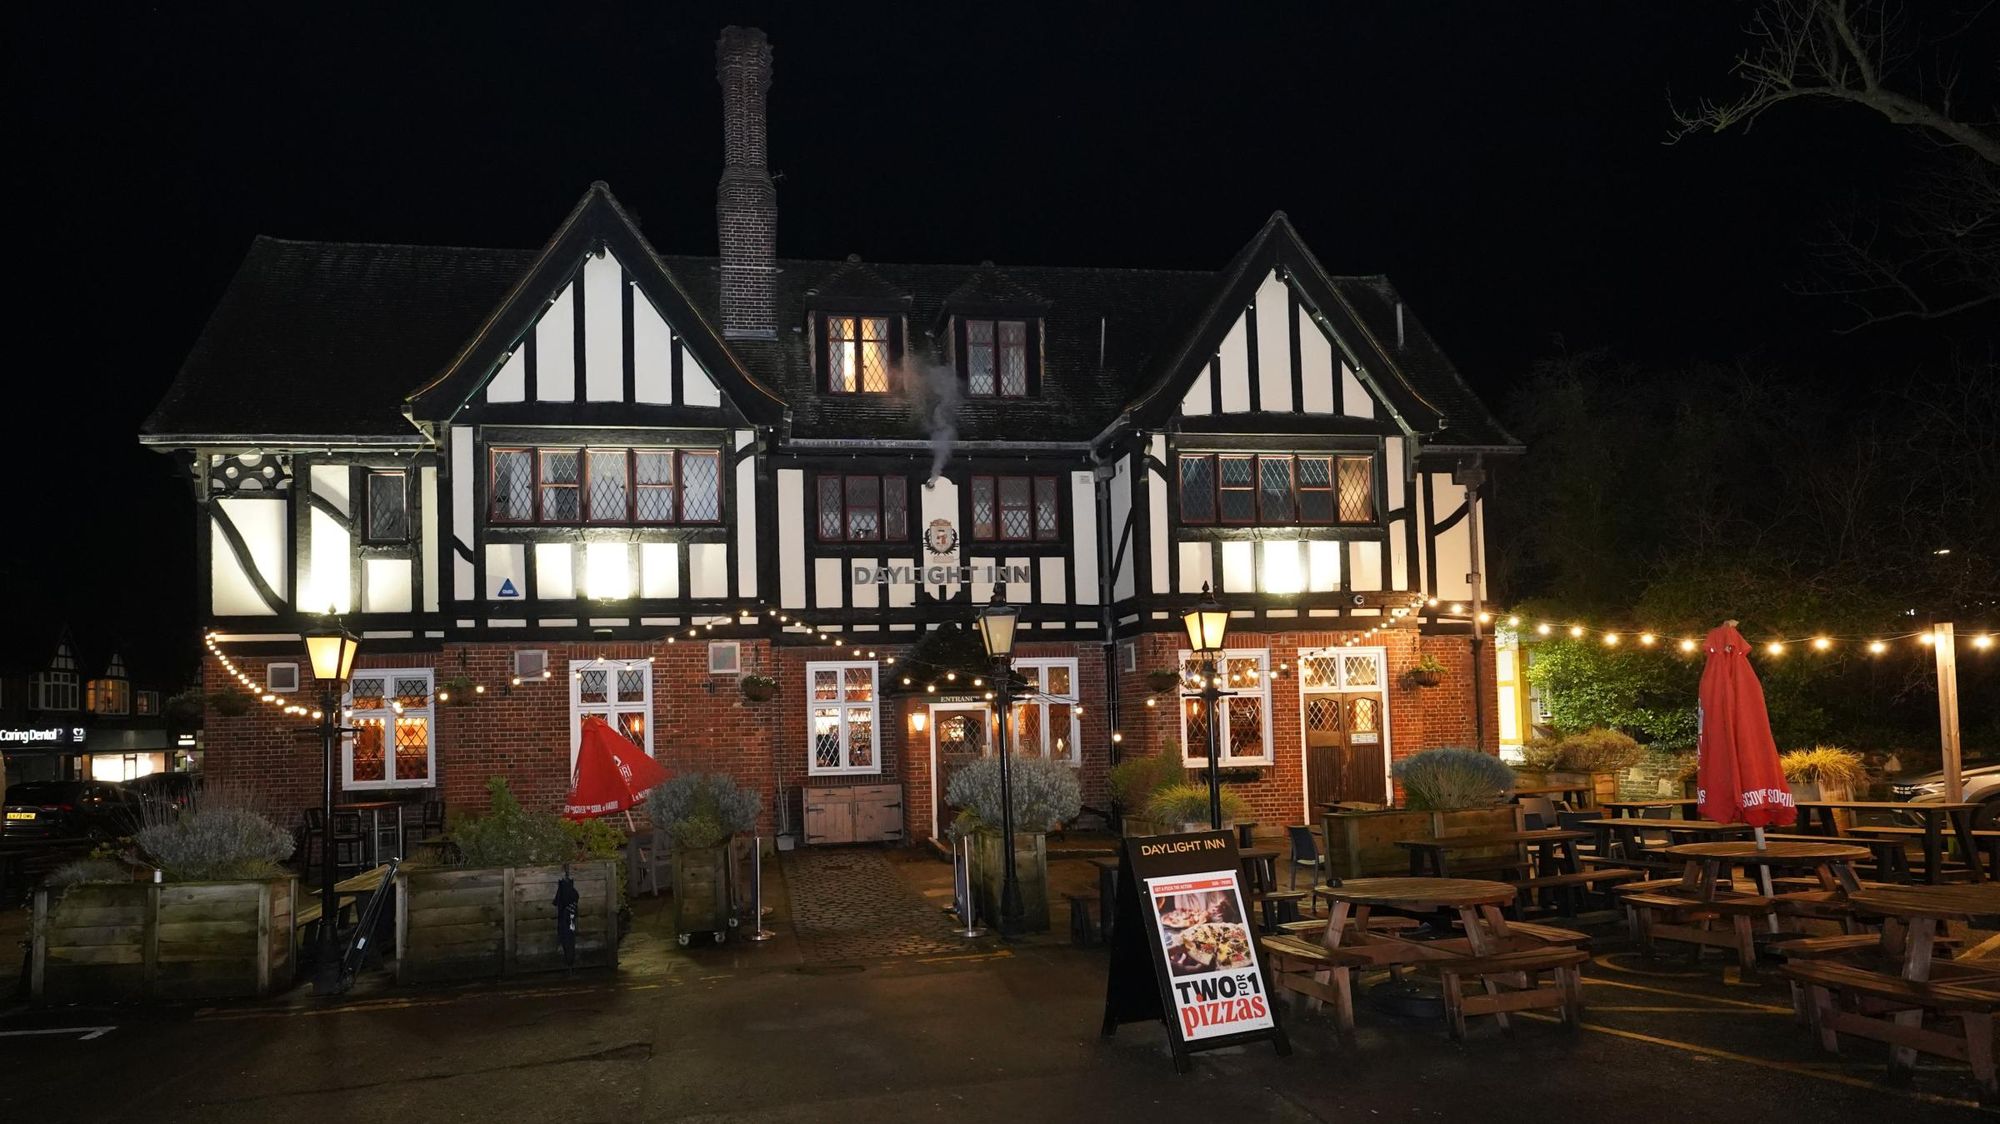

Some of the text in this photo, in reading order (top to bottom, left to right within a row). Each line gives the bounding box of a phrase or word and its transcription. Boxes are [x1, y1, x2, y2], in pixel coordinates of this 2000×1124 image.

[854, 566, 1030, 584] DAYLIGHT INN
[0, 728, 28, 743] Caring
[29, 728, 57, 740] Dental
[1141, 838, 1226, 856] DAYLIGHT INN
[1175, 972, 1260, 1004] TWO FOR 1
[1181, 993, 1266, 1037] pizzas
